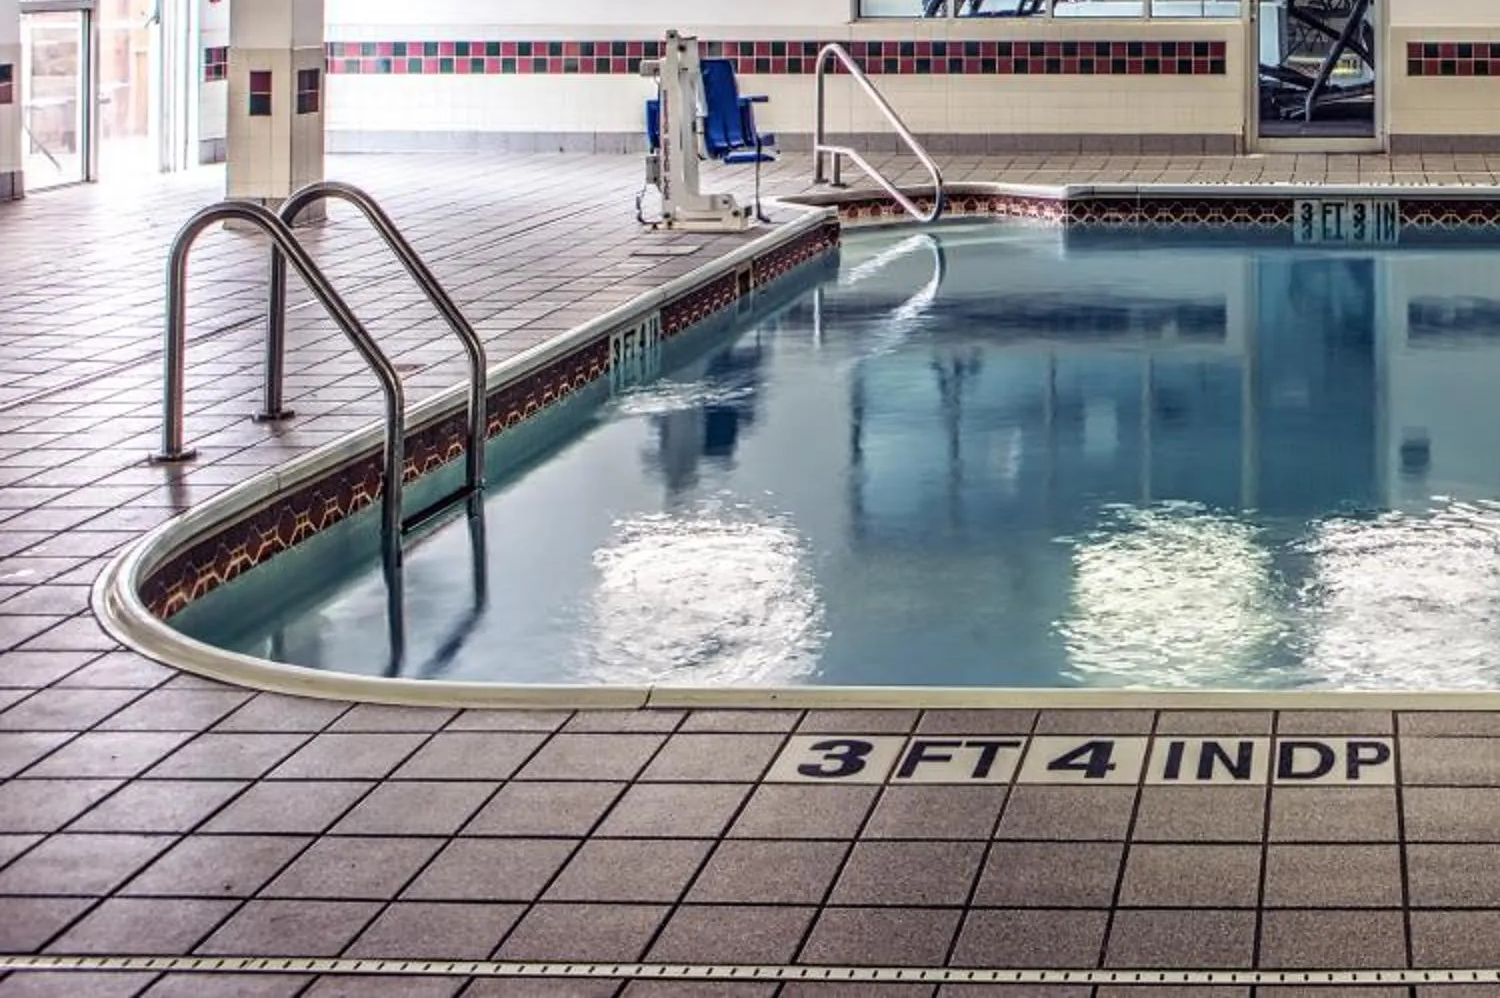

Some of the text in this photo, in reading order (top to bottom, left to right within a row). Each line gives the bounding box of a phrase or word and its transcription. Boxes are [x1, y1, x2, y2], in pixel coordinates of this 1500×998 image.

[1301, 202, 1396, 222] 3 FT 3 IN
[796, 740, 1391, 779] 3 FT 4 IN DP
